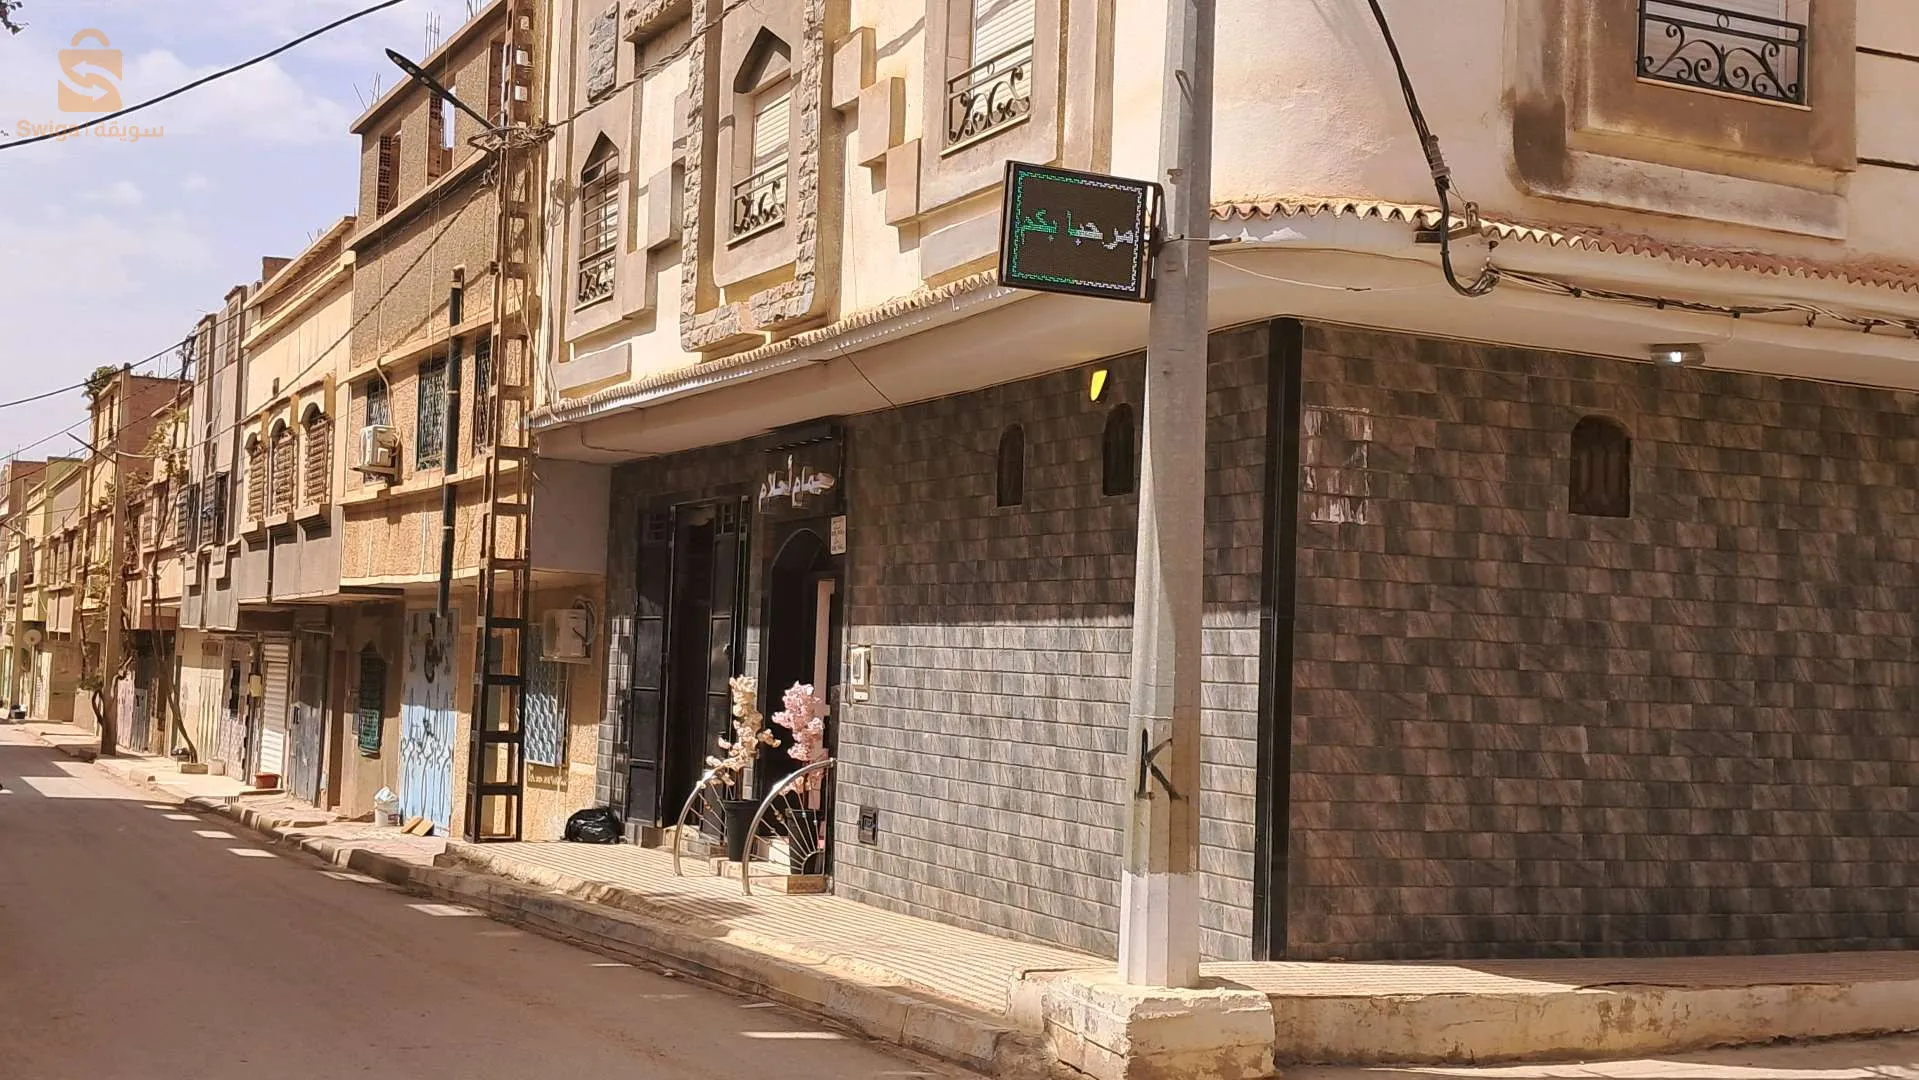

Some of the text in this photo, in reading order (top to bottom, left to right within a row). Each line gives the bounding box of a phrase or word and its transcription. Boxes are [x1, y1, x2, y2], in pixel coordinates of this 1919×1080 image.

[1021, 208, 1134, 250] مرحبا بكم
[791, 465, 835, 508] حمام
